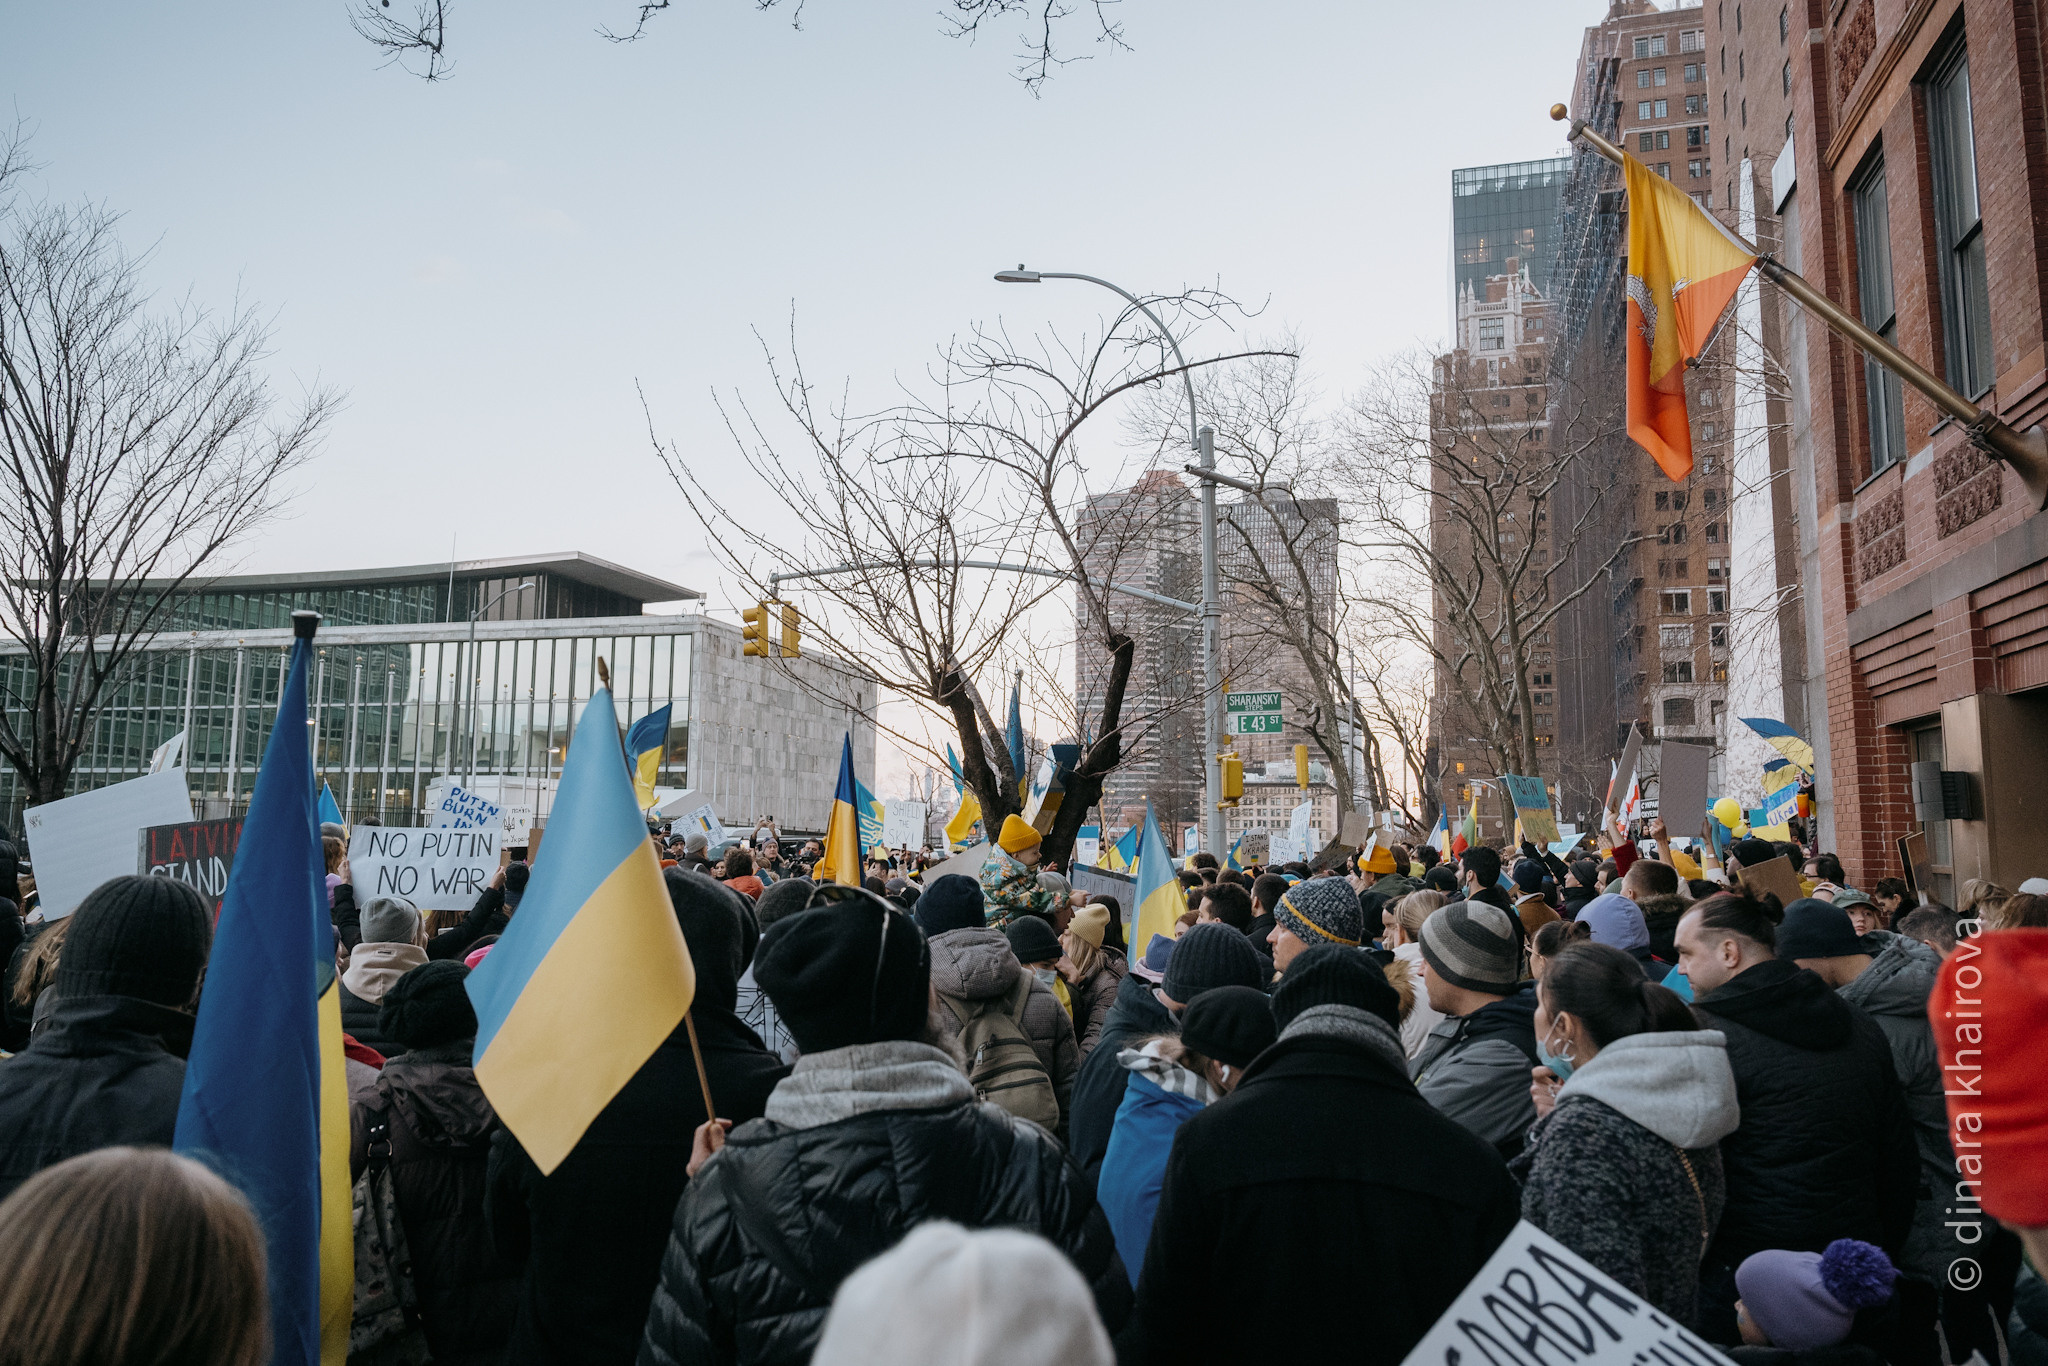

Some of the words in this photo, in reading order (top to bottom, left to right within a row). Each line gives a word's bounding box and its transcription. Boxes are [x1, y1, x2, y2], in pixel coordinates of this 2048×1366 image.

[1229, 693, 1279, 706] SHARANSKY
[1241, 716, 1247, 732] E
[1251, 716, 1266, 732] 43
[1270, 715, 1280, 724] ST
[441, 799, 488, 826] BURN
[892, 801, 921, 820] SHIELD
[899, 819, 910, 829] THE
[368, 831, 408, 858] NO
[420, 832, 493, 858] PUTIN
[889, 828, 915, 849] SKY!
[1274, 838, 1294, 852] BLOCK
[1242, 845, 1269, 855] UKRAINE
[377, 865, 418, 895] NO
[431, 867, 486, 895] WAR
[1445, 1244, 1638, 1366] ЛАВА
